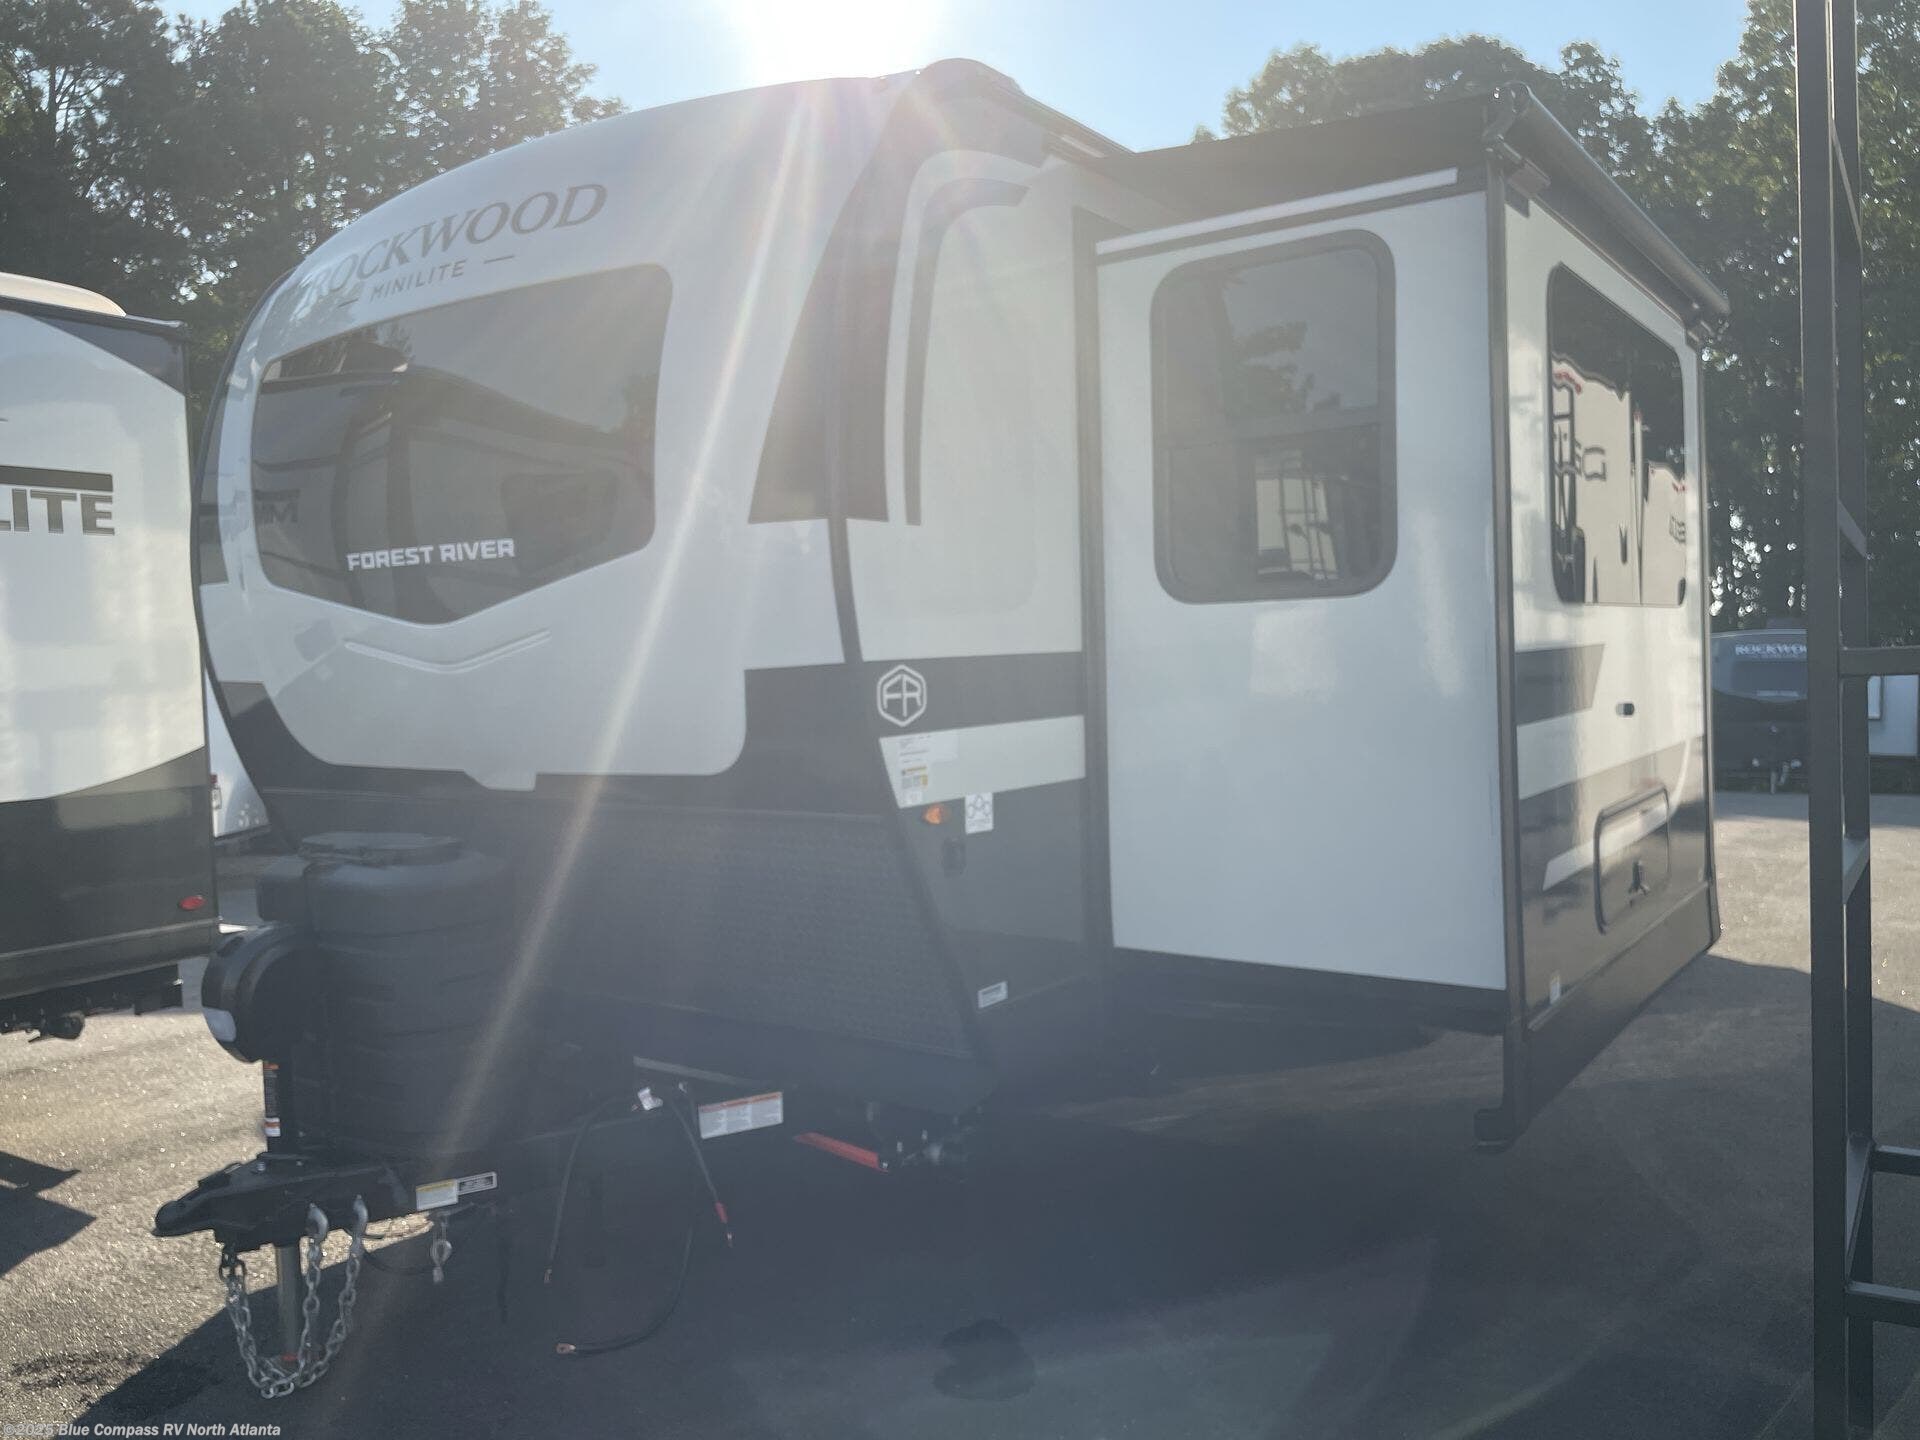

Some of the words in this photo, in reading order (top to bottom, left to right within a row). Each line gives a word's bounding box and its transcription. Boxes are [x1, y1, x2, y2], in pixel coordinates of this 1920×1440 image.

[303, 184, 608, 302] ROCKWOOD
[370, 258, 468, 303] MINILITE
[346, 544, 434, 571] FOREST
[438, 538, 515, 564] RIVER
